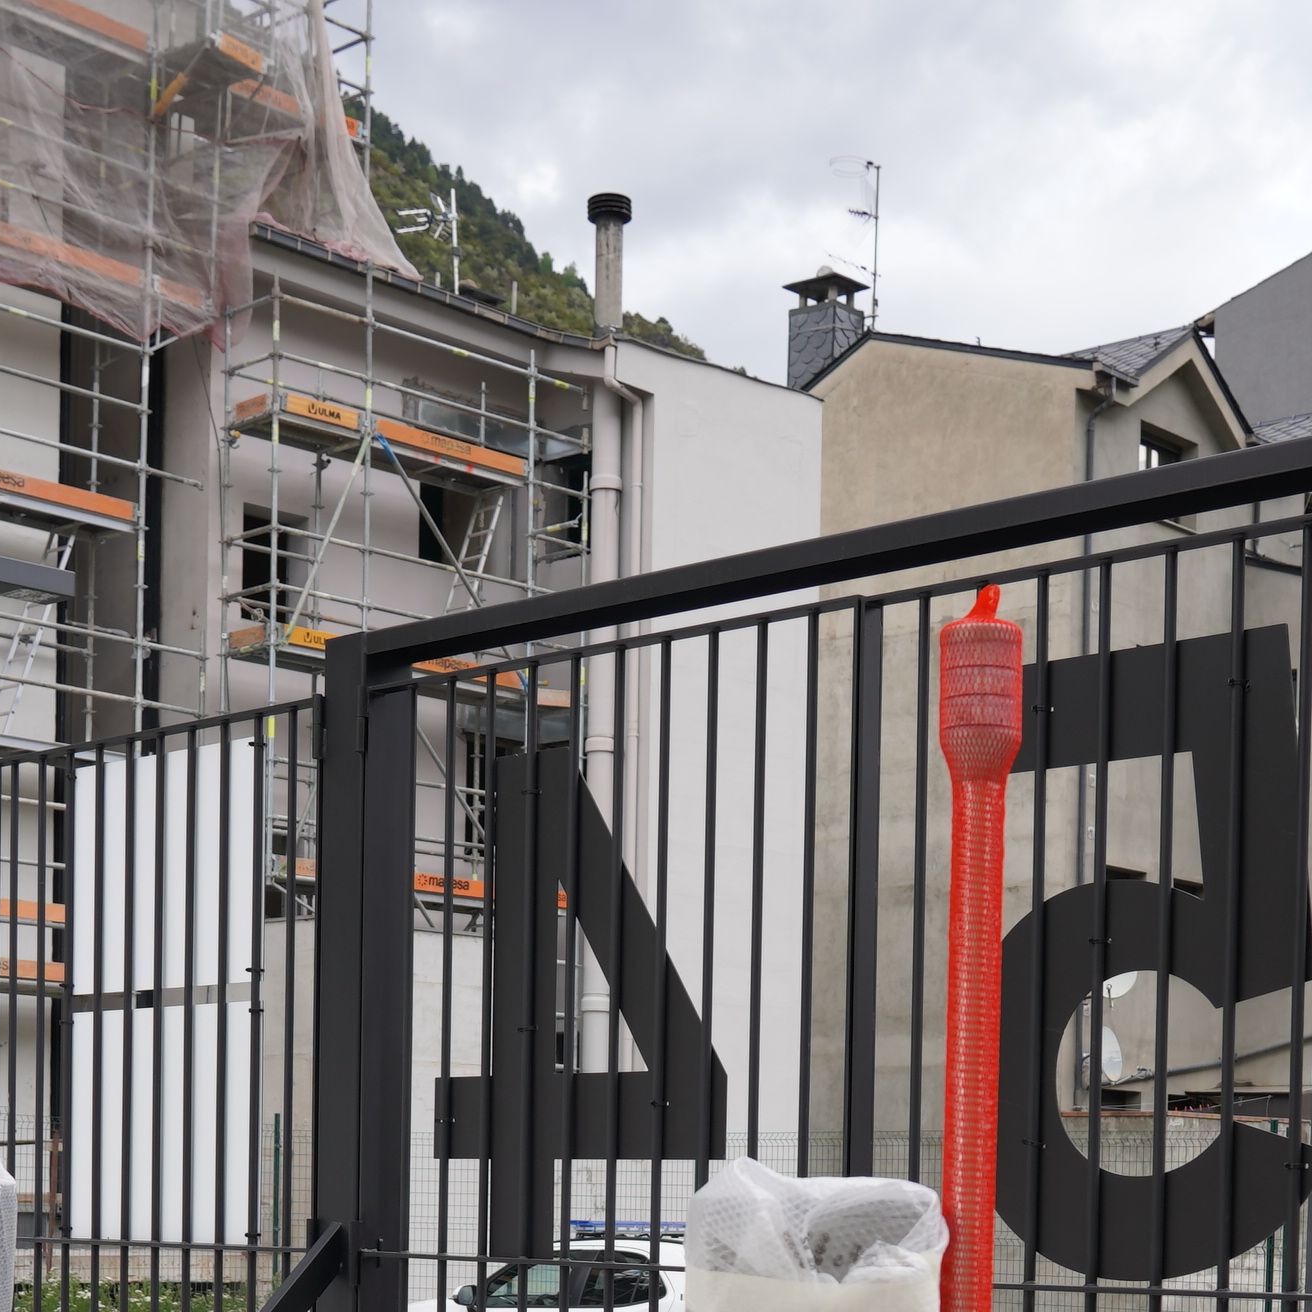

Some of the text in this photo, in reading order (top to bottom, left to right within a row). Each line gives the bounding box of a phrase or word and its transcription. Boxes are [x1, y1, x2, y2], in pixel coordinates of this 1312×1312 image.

[318, 407, 342, 420] ULMA
[431, 436, 472, 455] mapesa
[428, 876, 470, 891] maesa
